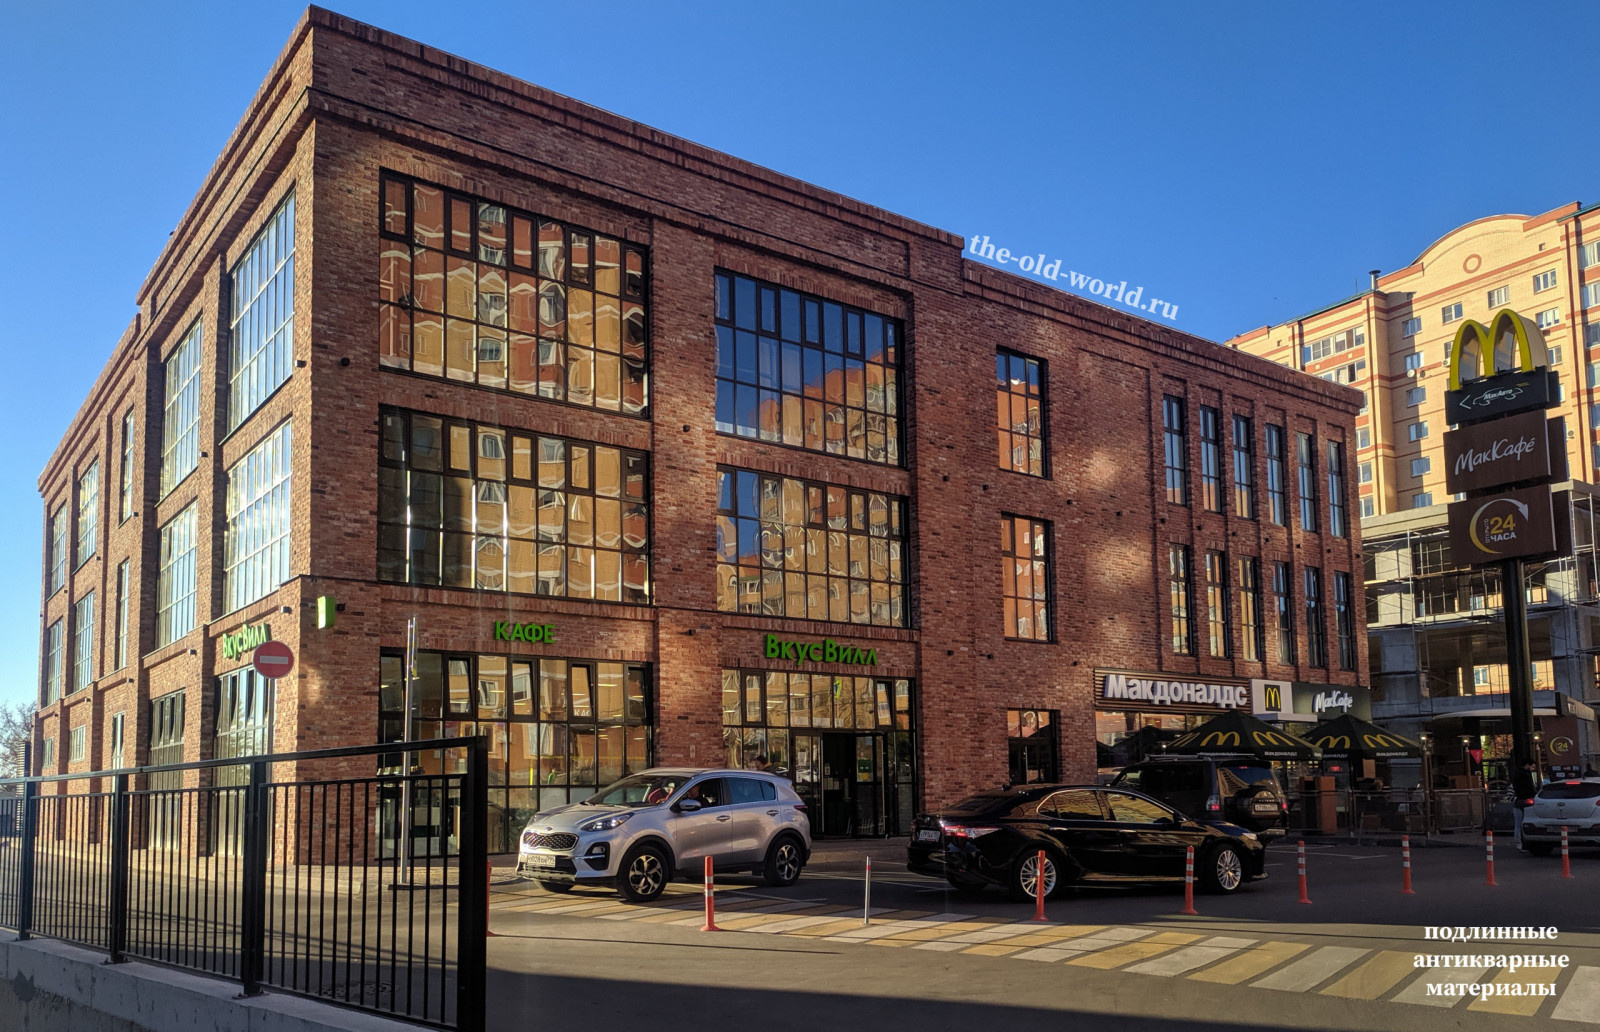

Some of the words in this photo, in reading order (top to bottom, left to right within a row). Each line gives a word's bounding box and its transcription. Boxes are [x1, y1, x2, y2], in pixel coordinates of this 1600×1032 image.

[1489, 514, 1516, 534] 24
[1490, 532, 1517, 542] ЧАСА
[222, 622, 267, 661] ВкусВилл
[494, 620, 556, 644] КАФЕ
[765, 633, 879, 667] ВкусВилл
[1104, 674, 1248, 709] Макдоналдс
